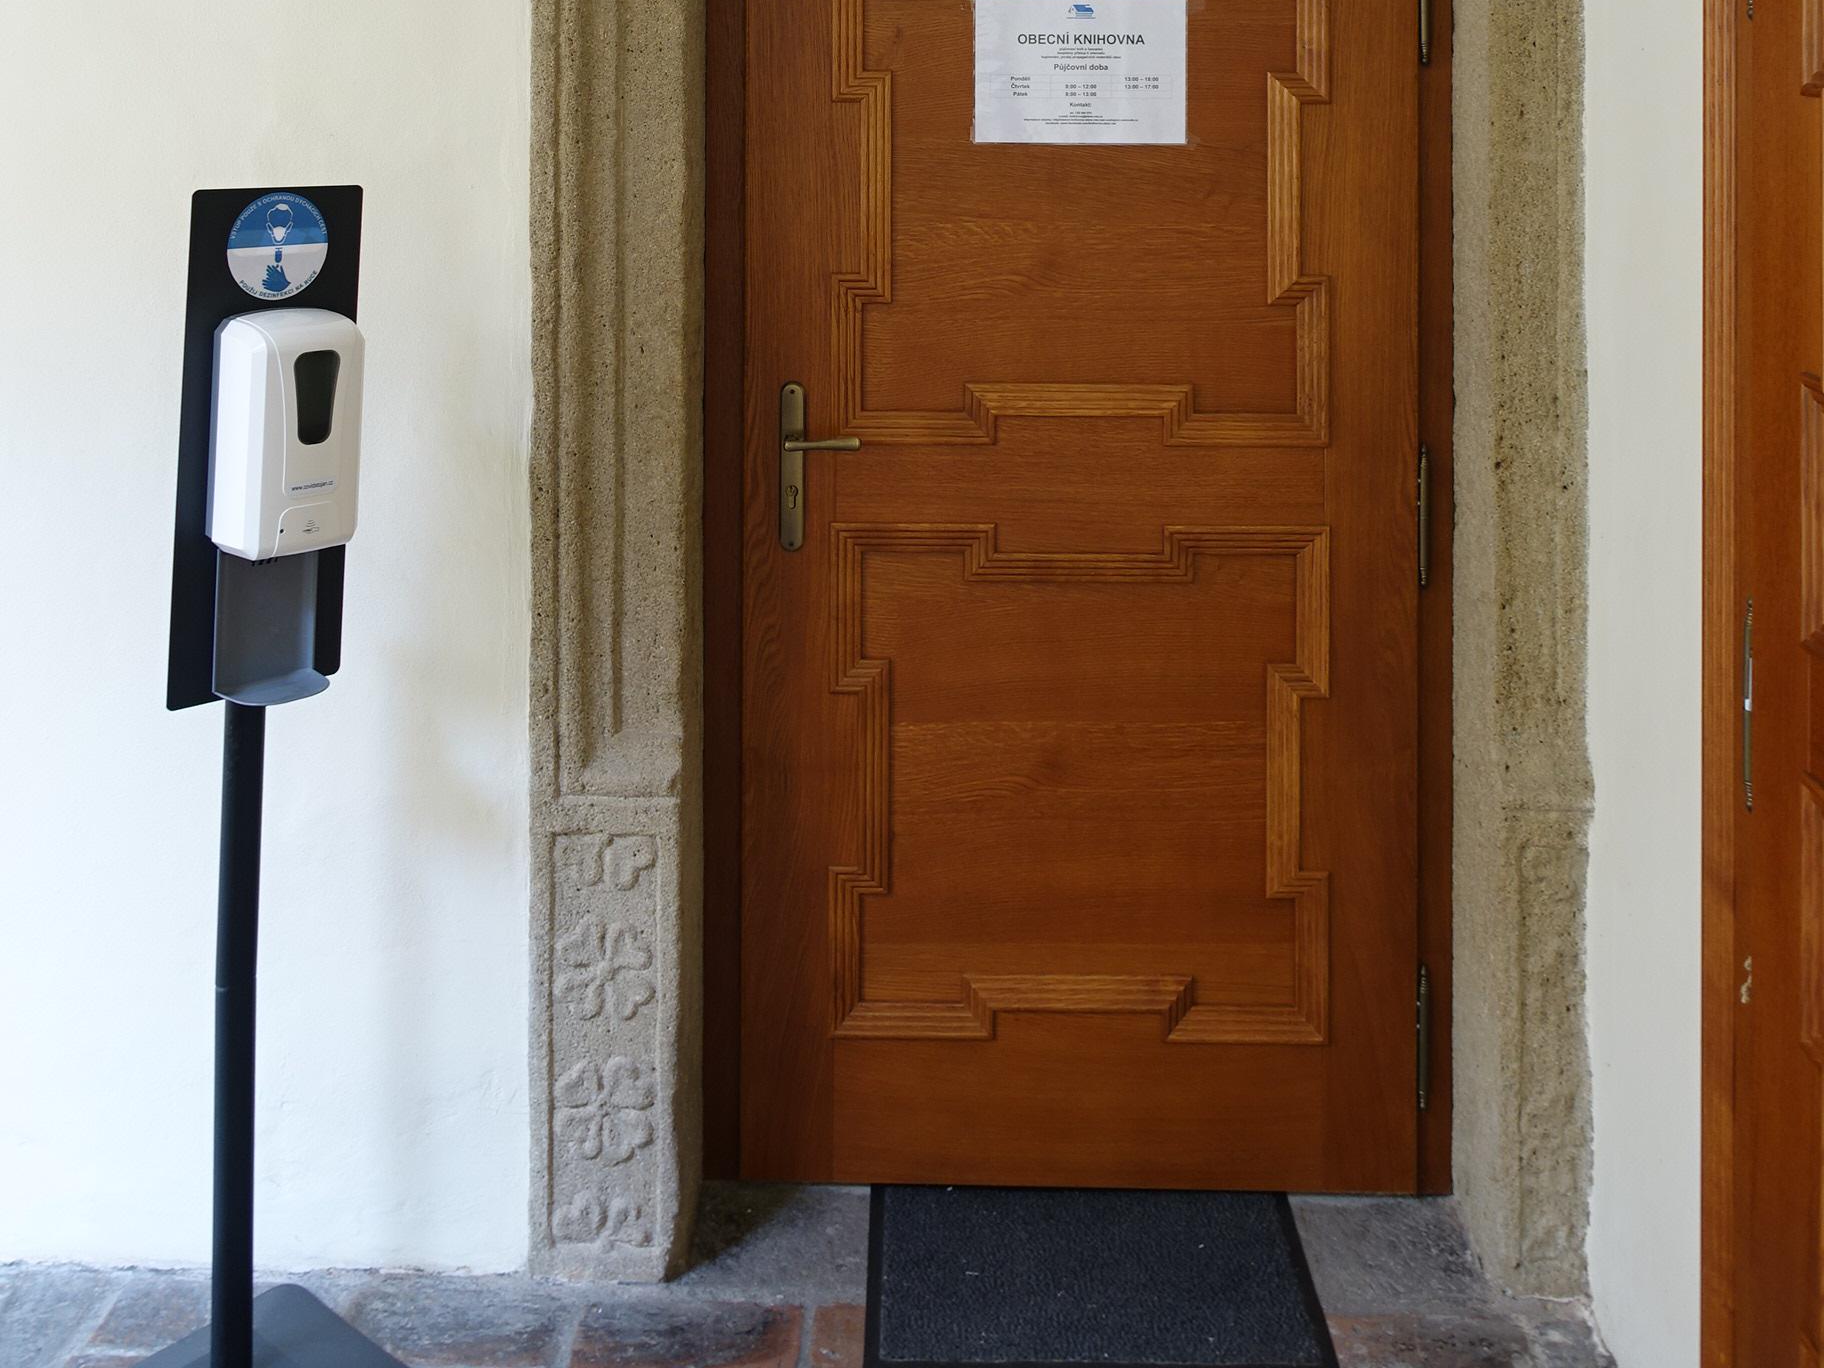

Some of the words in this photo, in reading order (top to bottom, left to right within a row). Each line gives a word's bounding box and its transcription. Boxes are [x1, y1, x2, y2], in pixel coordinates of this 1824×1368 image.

[1017, 32, 1070, 45] OBECNÍ
[1073, 34, 1145, 45] KNIHOVNA
[1053, 63, 1087, 72] Půjčovní
[1089, 63, 1109, 71] doba
